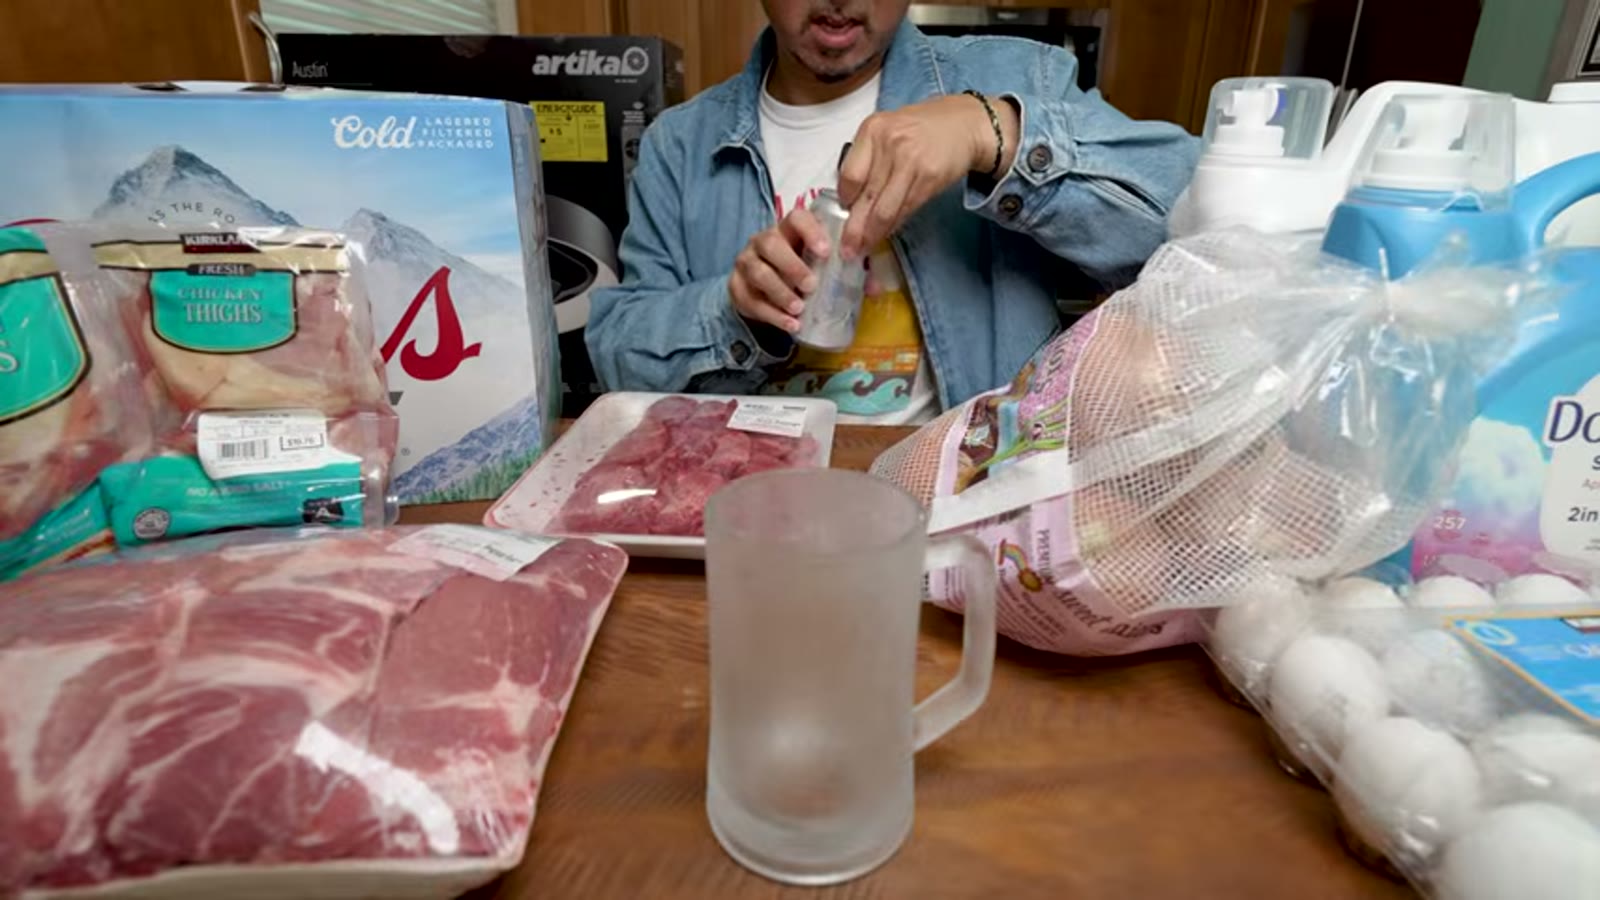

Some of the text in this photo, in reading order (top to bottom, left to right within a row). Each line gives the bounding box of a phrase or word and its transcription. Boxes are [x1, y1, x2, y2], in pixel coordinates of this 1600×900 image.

[532, 50, 621, 75] artika
[292, 61, 328, 78] Austin
[331, 115, 491, 149] Cold LAGERED
[422, 128, 492, 138] FILTERED
[418, 140, 494, 149] PACKAGED
[170, 202, 203, 213] THE
[198, 265, 244, 275] FRESH
[178, 288, 260, 300] CHICKEN
[185, 303, 262, 323] THIGHS
[1433, 516, 1467, 530] 257
